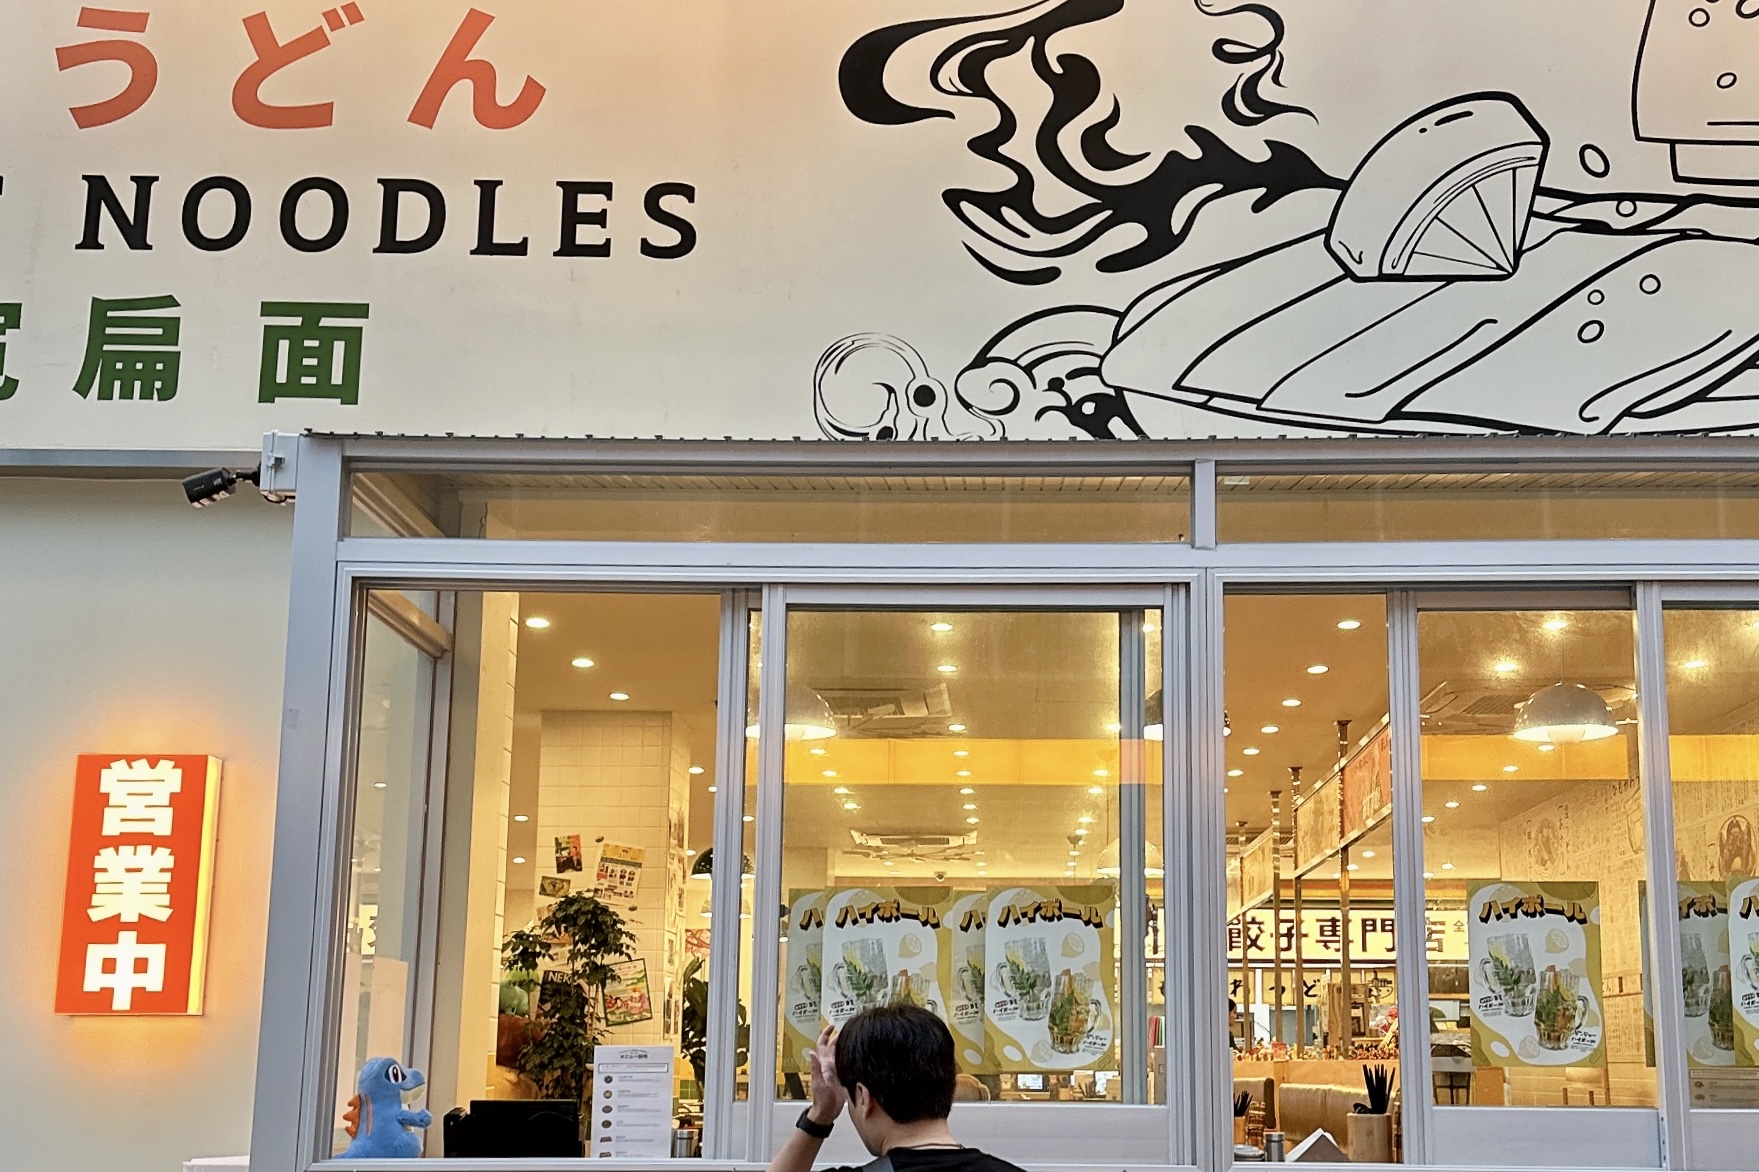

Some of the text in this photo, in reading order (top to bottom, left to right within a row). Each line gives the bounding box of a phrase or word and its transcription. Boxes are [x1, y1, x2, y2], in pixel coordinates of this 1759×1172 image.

[55, 1, 546, 131] うどん
[75, 174, 697, 259] NOODLES
[0, 294, 370, 405] 扁面
[82, 758, 183, 1011] 営業中
[835, 898, 942, 929] ハイボール
[997, 899, 1104, 929] ハイボール
[1479, 894, 1588, 925] ハイボール
